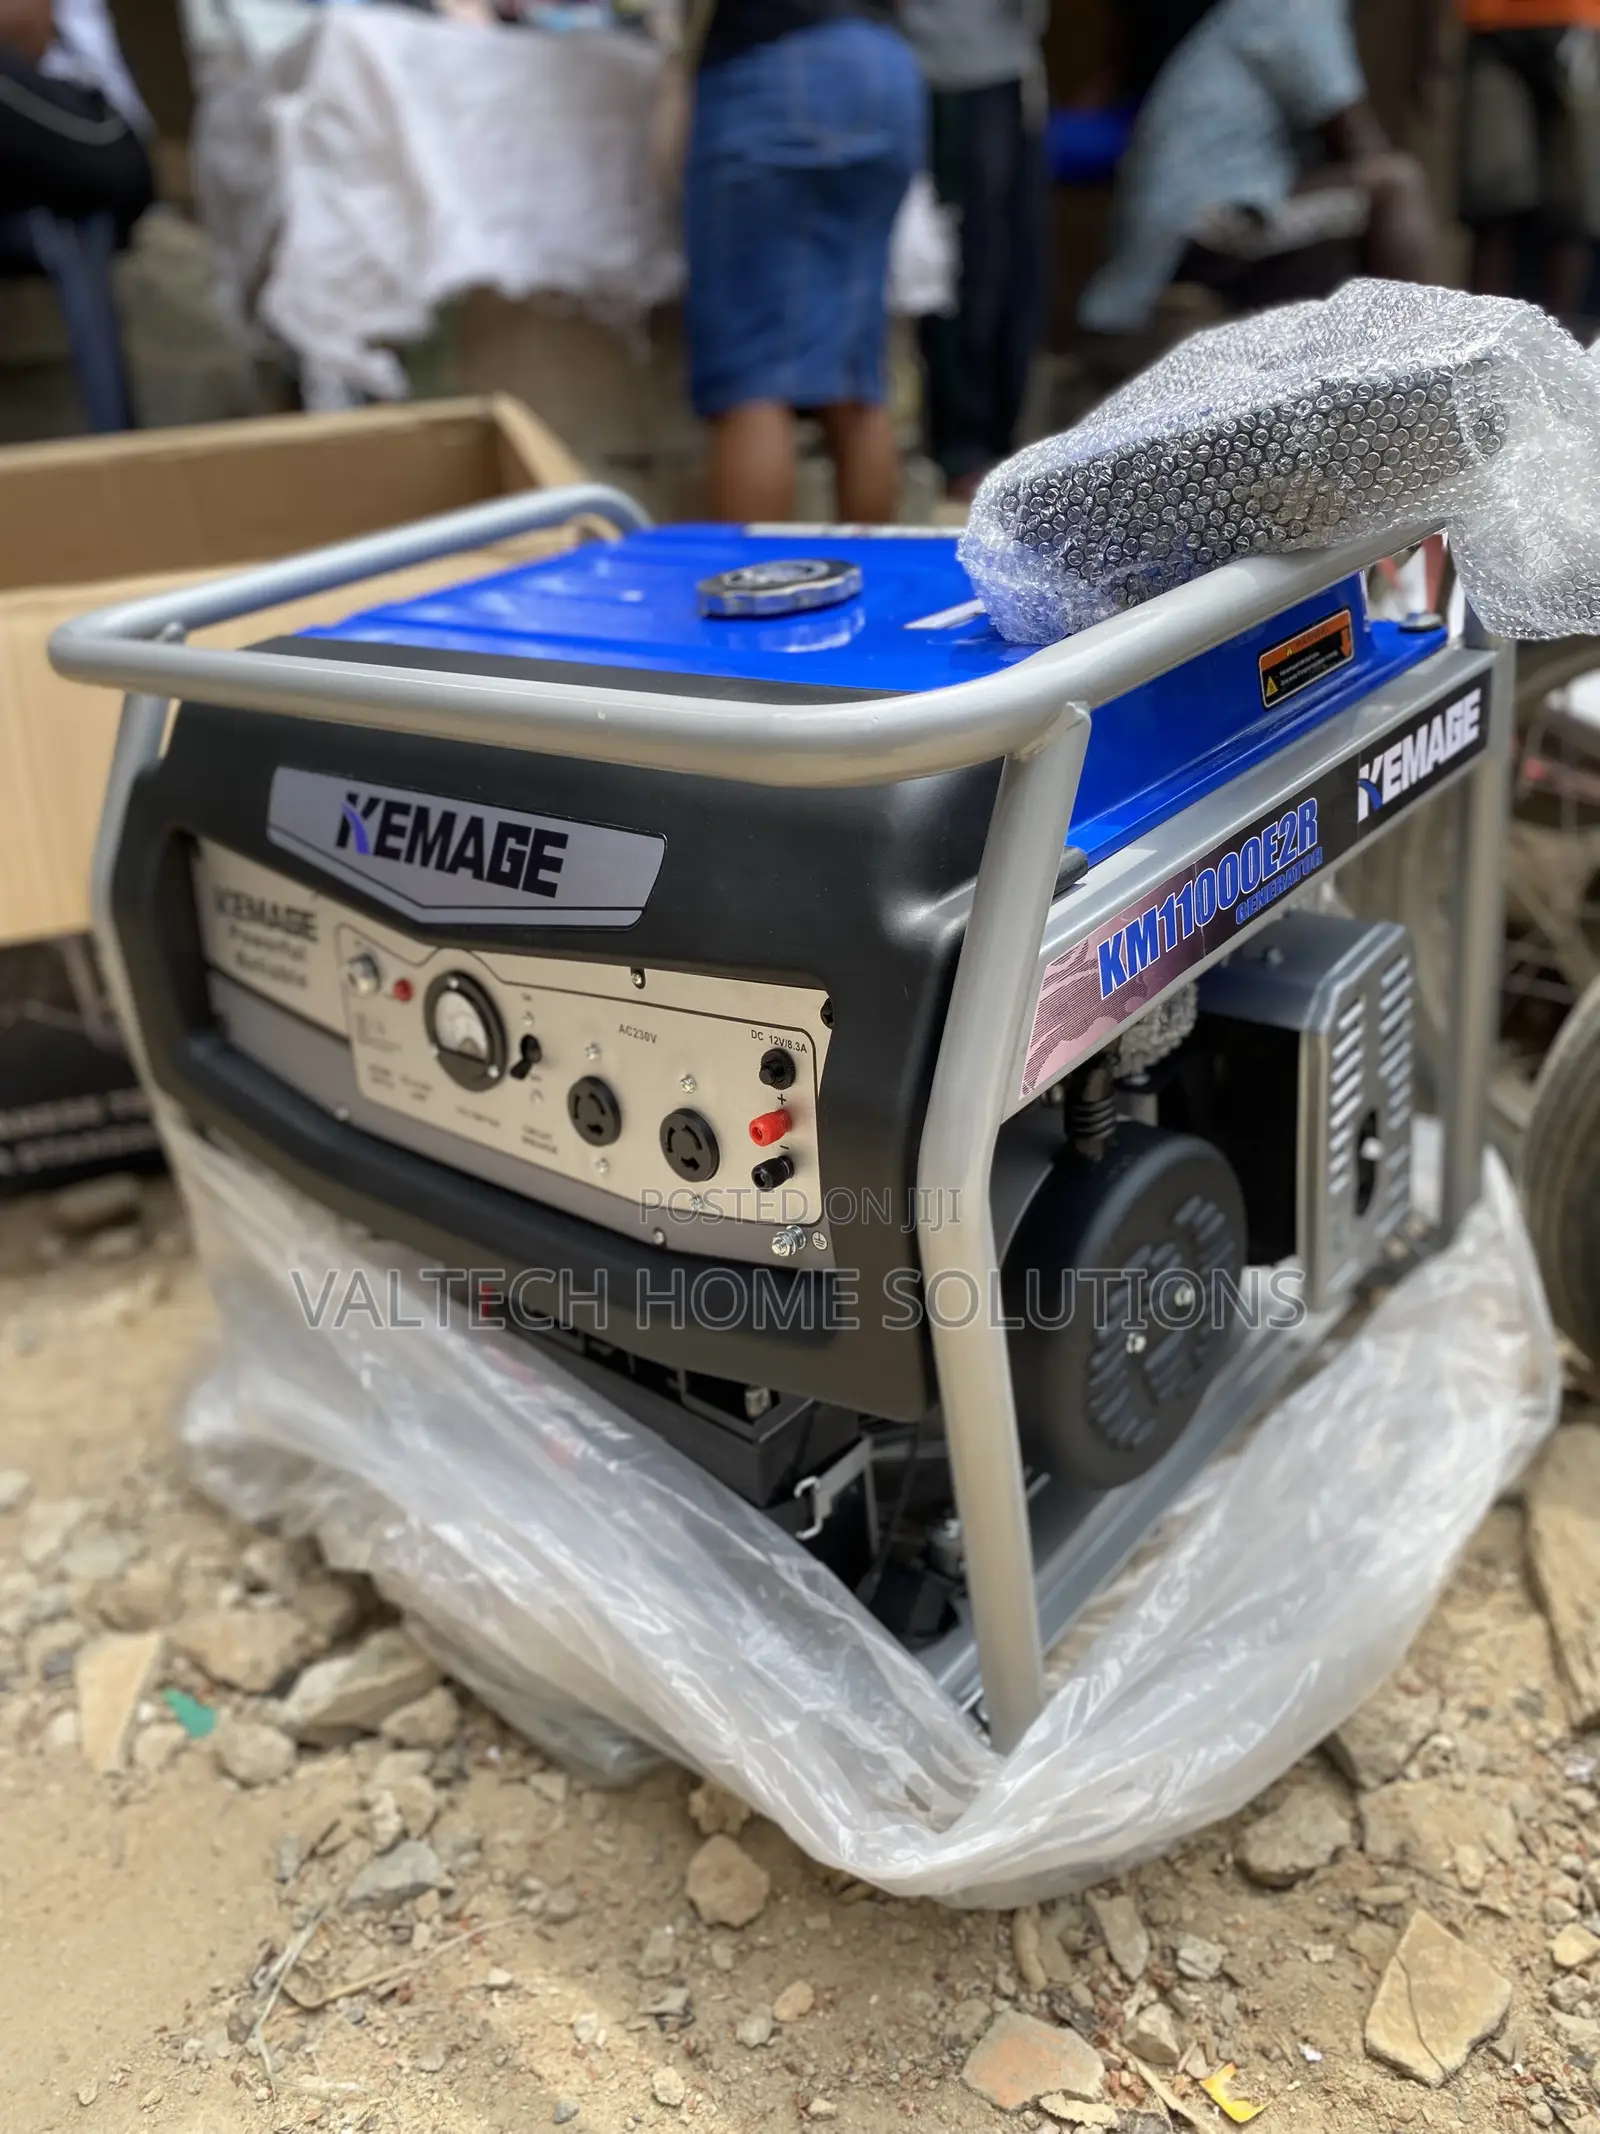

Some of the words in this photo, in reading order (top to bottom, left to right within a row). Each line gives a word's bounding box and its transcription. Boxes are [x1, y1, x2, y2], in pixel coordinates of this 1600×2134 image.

[1357, 688, 1482, 823] KEMAGE
[335, 792, 570, 899] KEMAGE
[1235, 846, 1324, 926] GENERATOR
[1097, 797, 1319, 1000] KM11000E2R
[618, 1023, 658, 1044] AC230V
[751, 1029, 764, 1042] DC
[768, 1035, 808, 1054] 12V/8.3A
